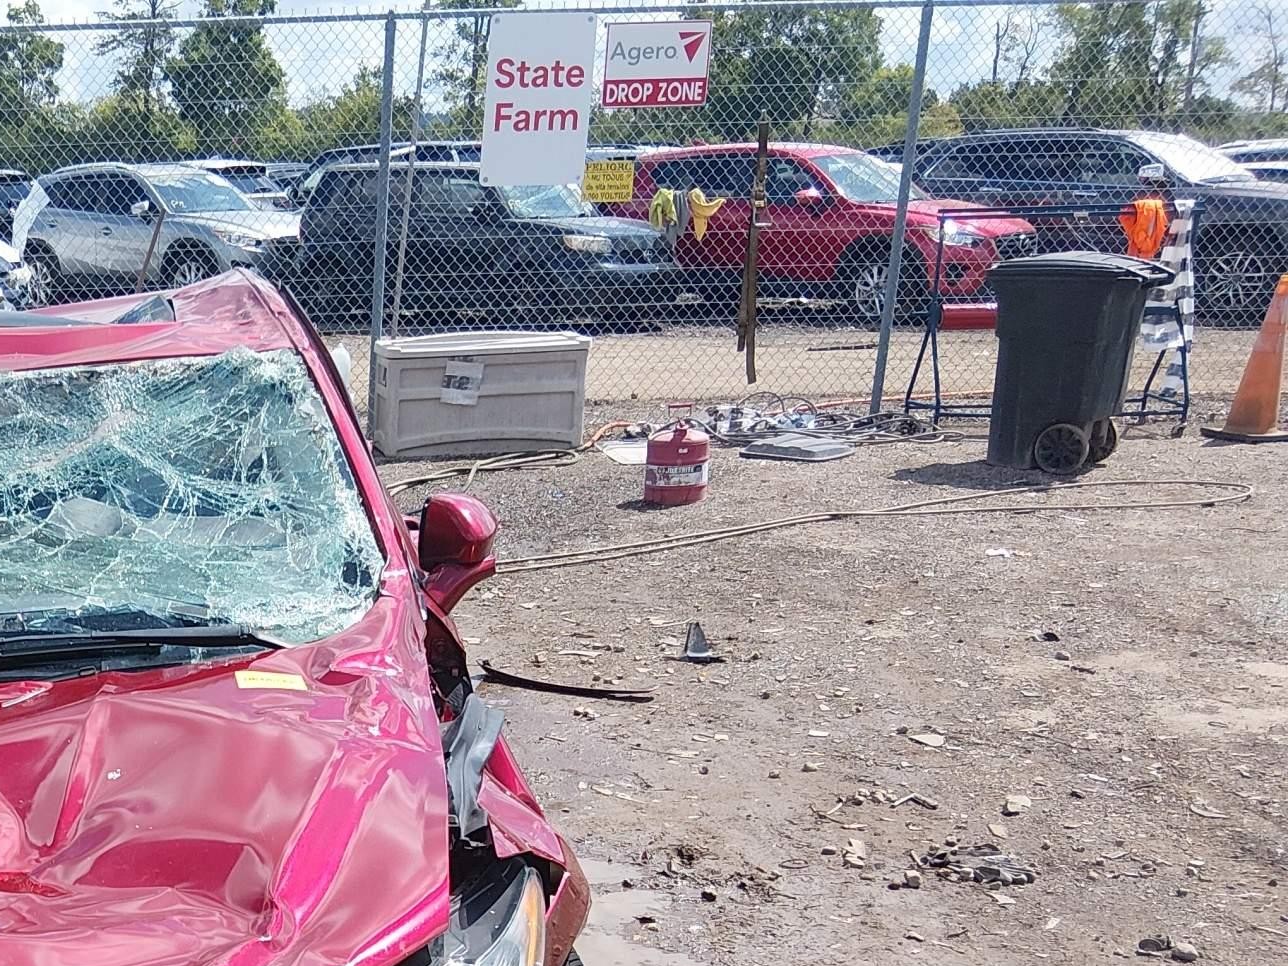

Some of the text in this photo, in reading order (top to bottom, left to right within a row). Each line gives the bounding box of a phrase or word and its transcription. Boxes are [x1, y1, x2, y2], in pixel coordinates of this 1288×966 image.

[610, 41, 677, 66] Agero
[494, 58, 585, 88] State
[605, 81, 704, 103] DROP ZONE
[494, 102, 579, 132] Farm
